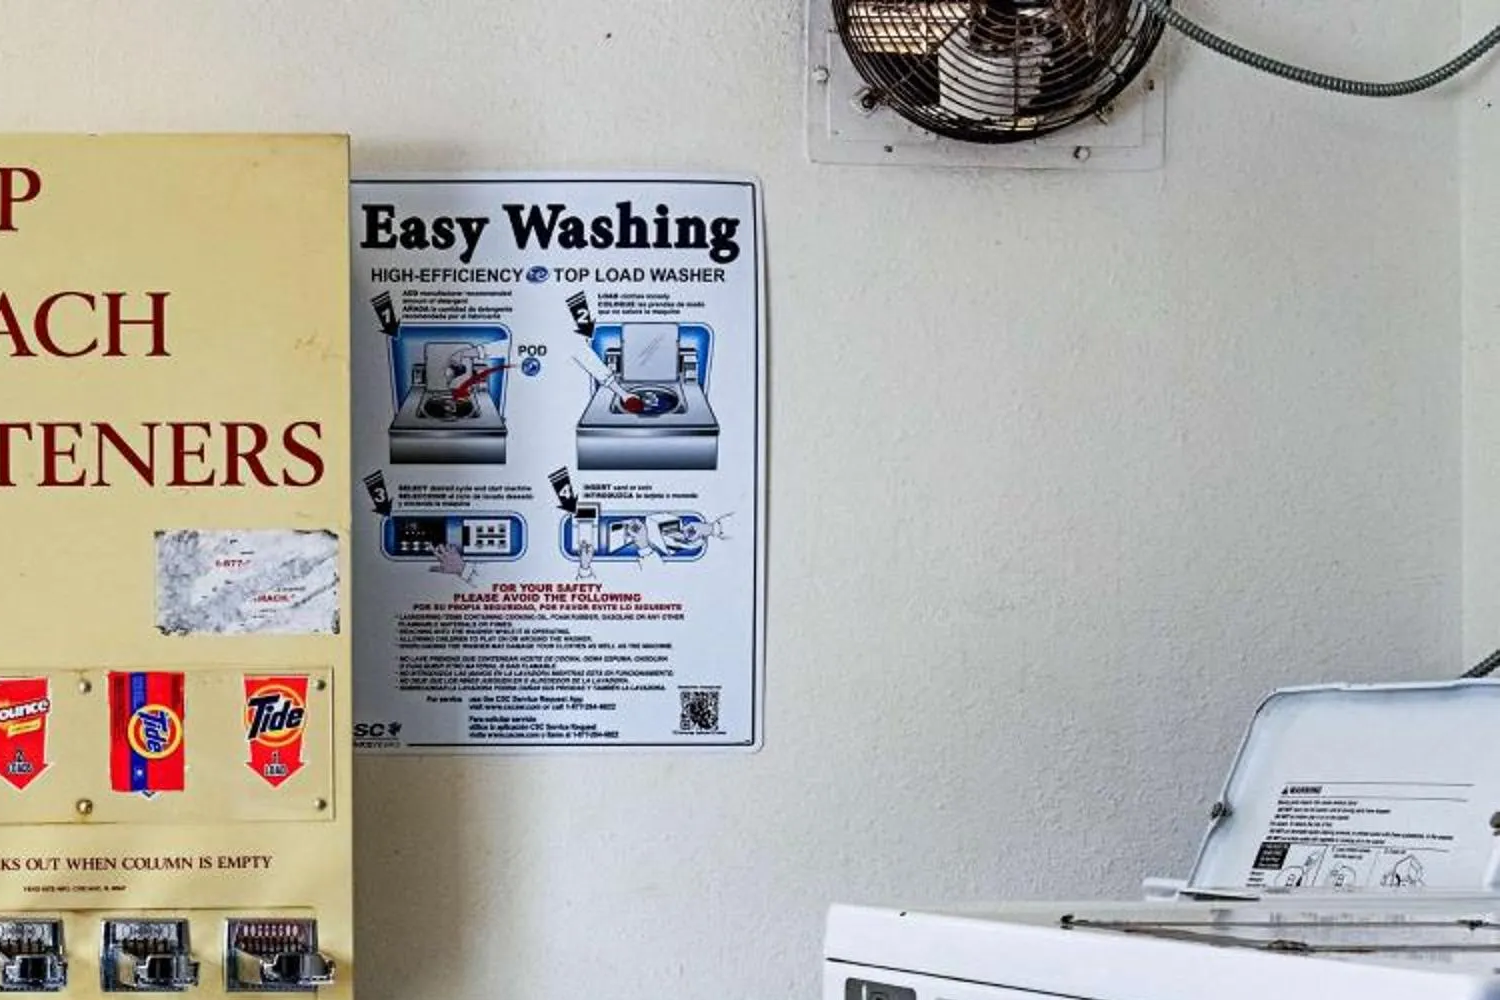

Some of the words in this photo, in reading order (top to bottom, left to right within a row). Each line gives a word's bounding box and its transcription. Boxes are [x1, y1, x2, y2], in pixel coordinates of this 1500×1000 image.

[361, 201, 490, 264] Easy
[502, 201, 740, 264] Washing
[371, 268, 522, 283] HIGH-EFFICIENCY
[554, 268, 588, 283] TOP
[595, 268, 644, 283] LOAD
[650, 268, 725, 283] WASHER
[578, 310, 588, 323] 2
[519, 345, 547, 357] POD
[374, 488, 385, 502] 3
[559, 485, 570, 498] 4
[492, 584, 516, 592] FOR
[520, 584, 552, 592] YOUR
[557, 584, 602, 592] SAFETY
[454, 593, 498, 602] PLEASE
[503, 593, 539, 602] AVOID
[545, 593, 566, 602] THE
[571, 593, 642, 602] FOLLOWING
[248, 695, 305, 740] Tide
[137, 709, 167, 753] Tide
[26, 856, 59, 872] OUT
[66, 856, 116, 872] WHEN
[121, 855, 192, 872] COLUMN
[199, 855, 212, 871] IS
[217, 855, 273, 871] EMPTY
